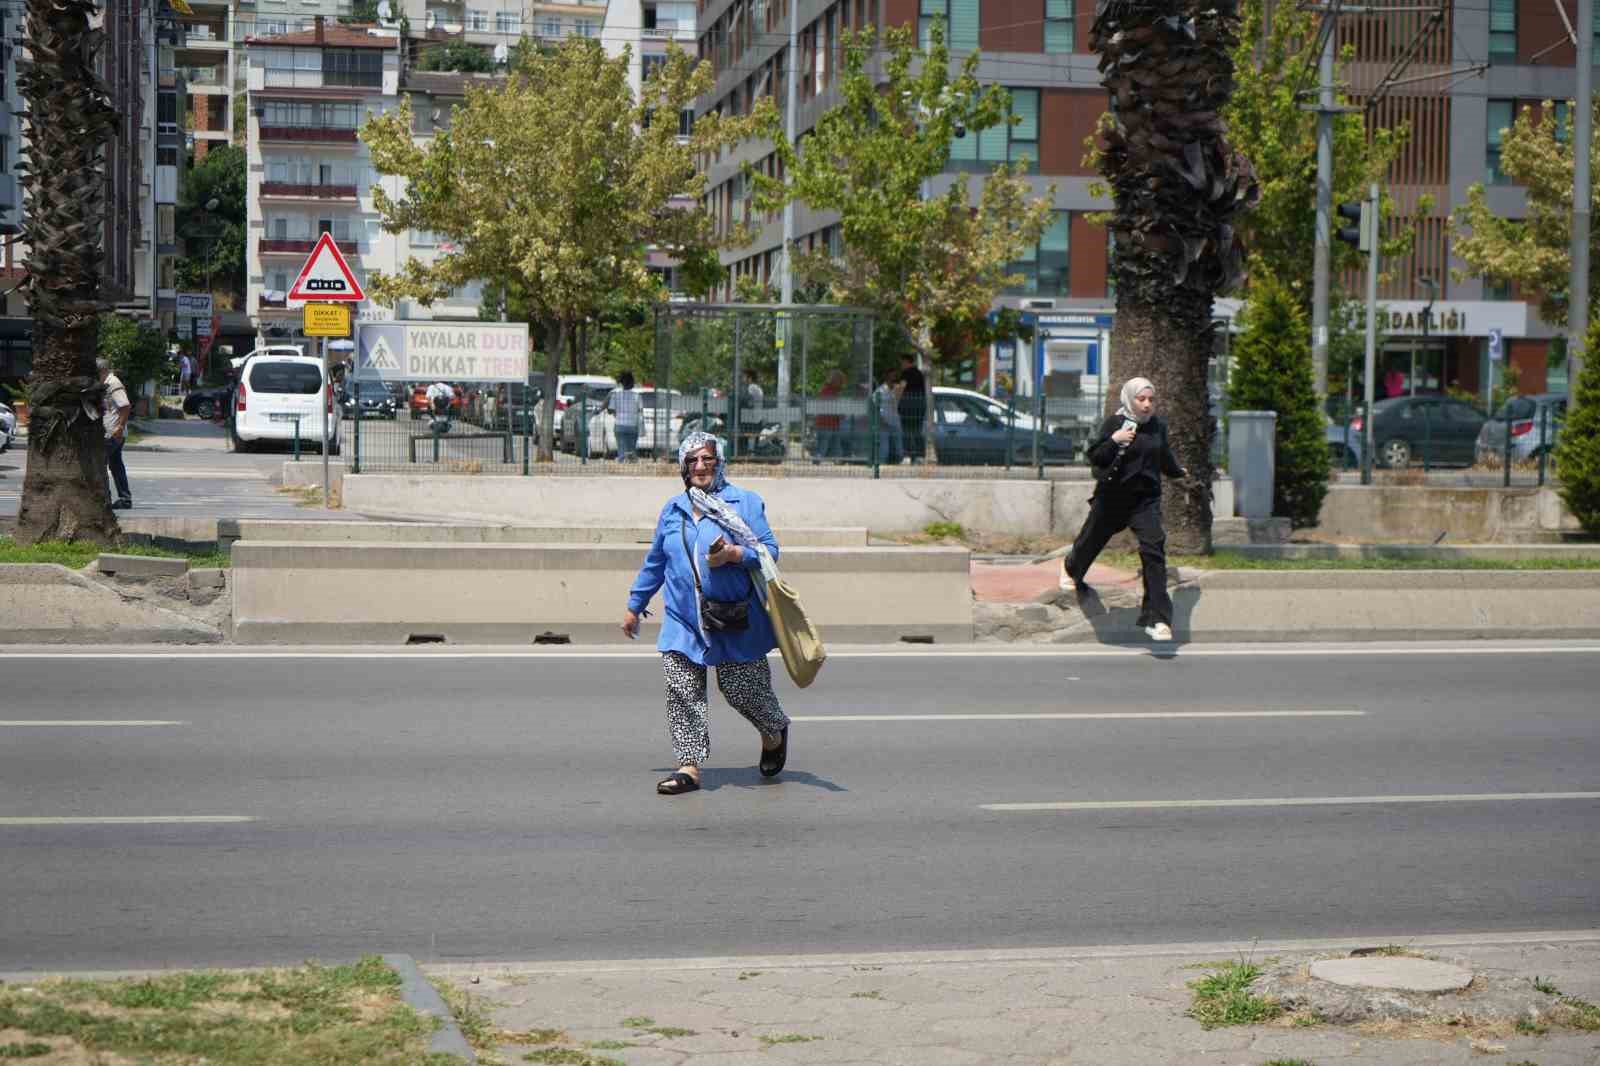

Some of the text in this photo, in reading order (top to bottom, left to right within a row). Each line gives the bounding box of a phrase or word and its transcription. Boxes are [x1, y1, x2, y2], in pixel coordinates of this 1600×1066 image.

[410, 331, 523, 350] YAYALAR DUR
[410, 354, 526, 375] DİKKAT TREN
